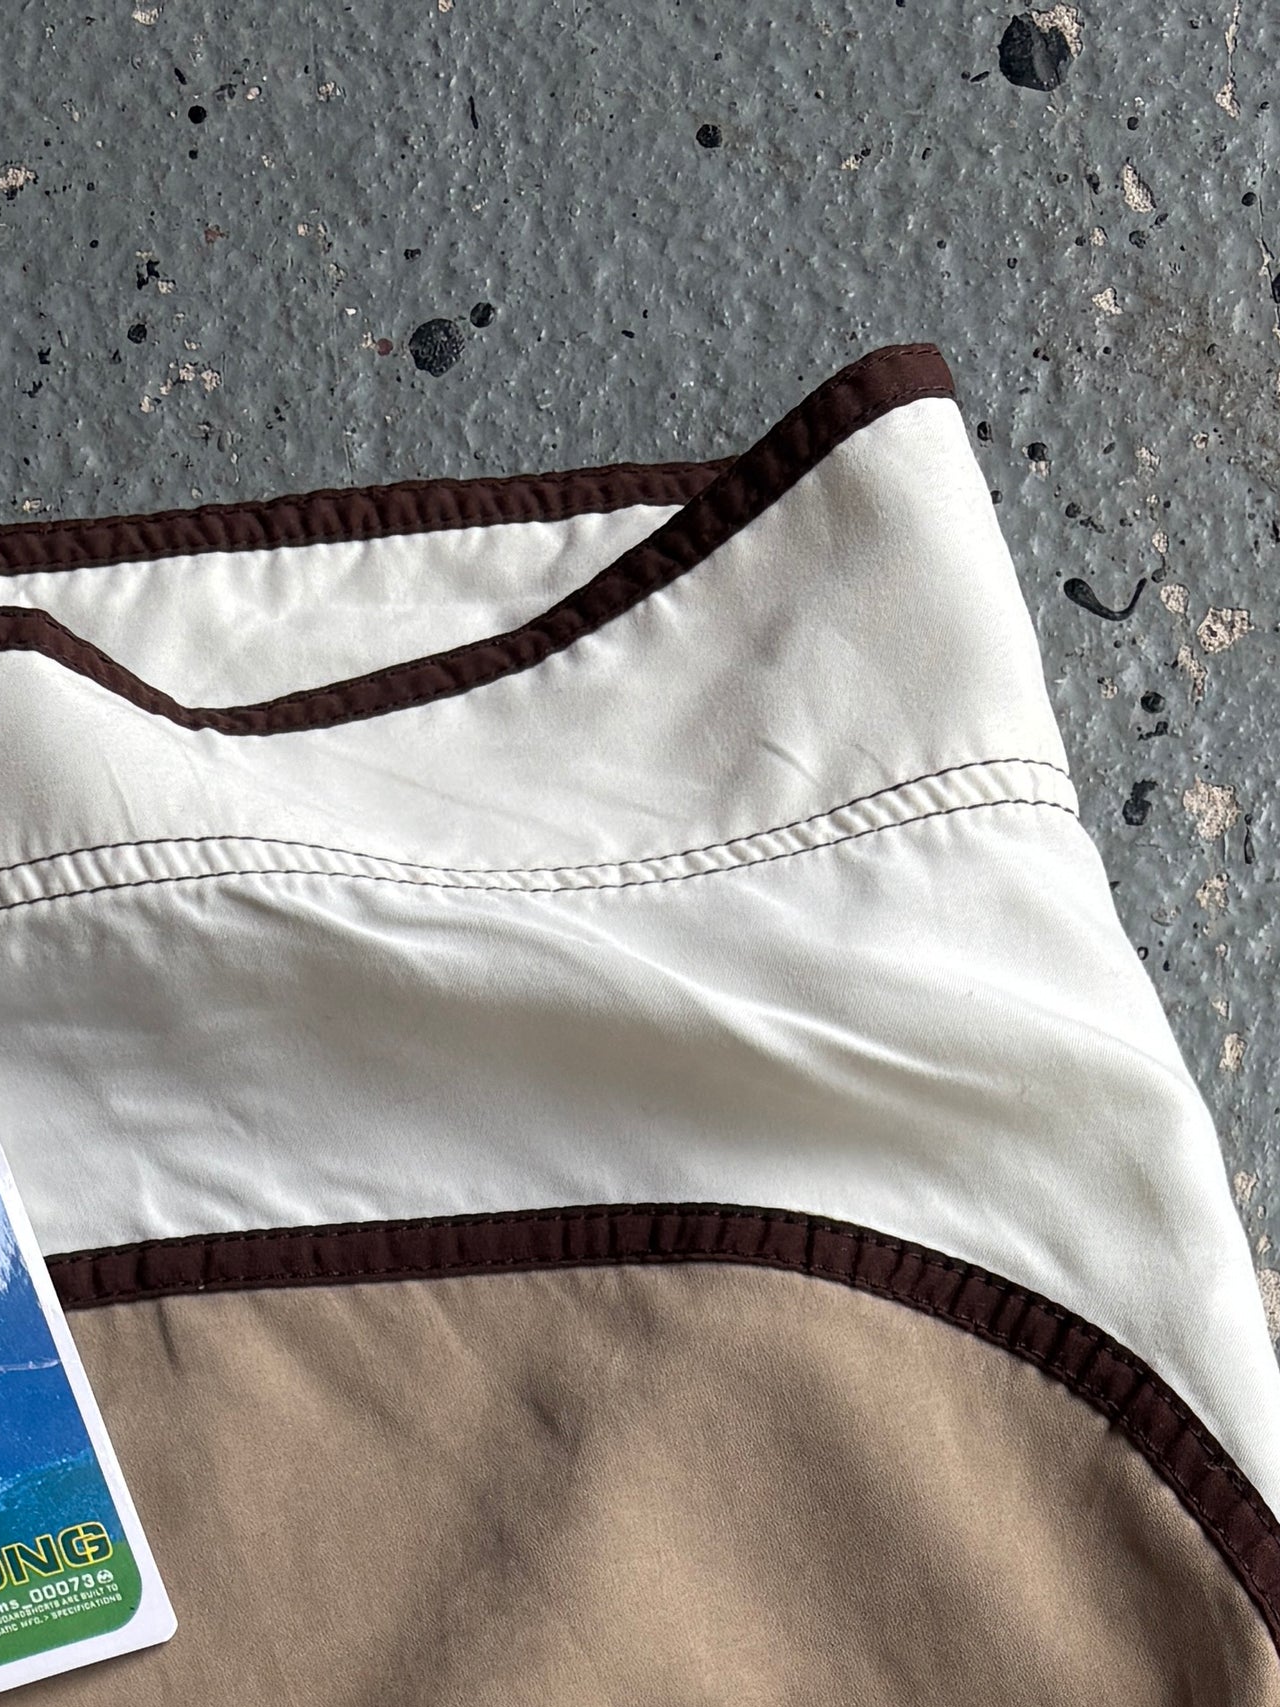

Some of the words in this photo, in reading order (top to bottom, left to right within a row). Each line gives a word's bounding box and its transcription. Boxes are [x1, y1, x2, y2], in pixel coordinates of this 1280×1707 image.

[51, 1593, 122, 1619] SPECIFICATIONS
[62, 1594, 79, 1605] ARE
[80, 1587, 104, 1600] BUILT
[106, 1583, 118, 1592] TO
